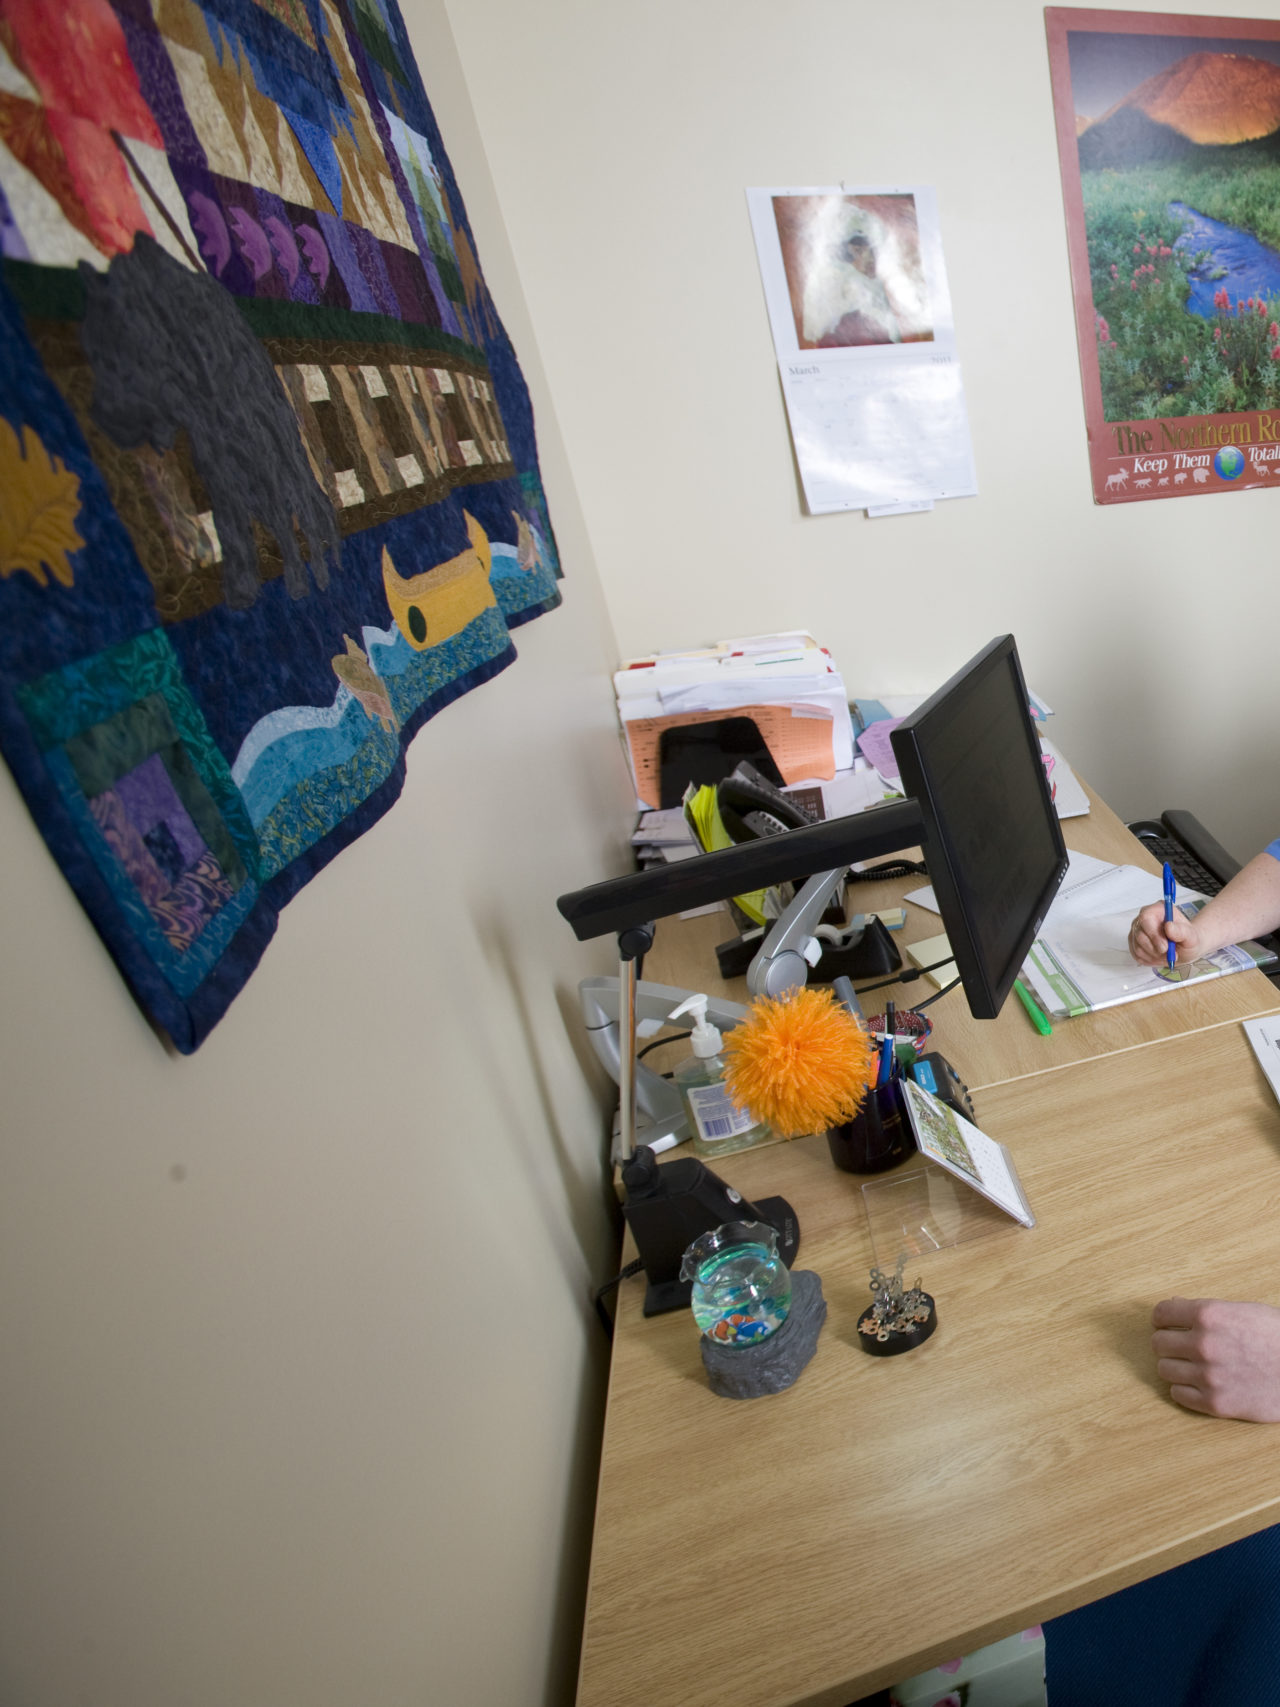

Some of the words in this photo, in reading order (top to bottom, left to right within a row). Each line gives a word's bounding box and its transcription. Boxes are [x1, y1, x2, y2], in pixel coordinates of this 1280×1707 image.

[788, 365, 821, 376] March
[1112, 424, 1153, 456] The
[1160, 420, 1252, 452] Northern
[1133, 456, 1168, 476] Keep
[1173, 453, 1211, 470] Them
